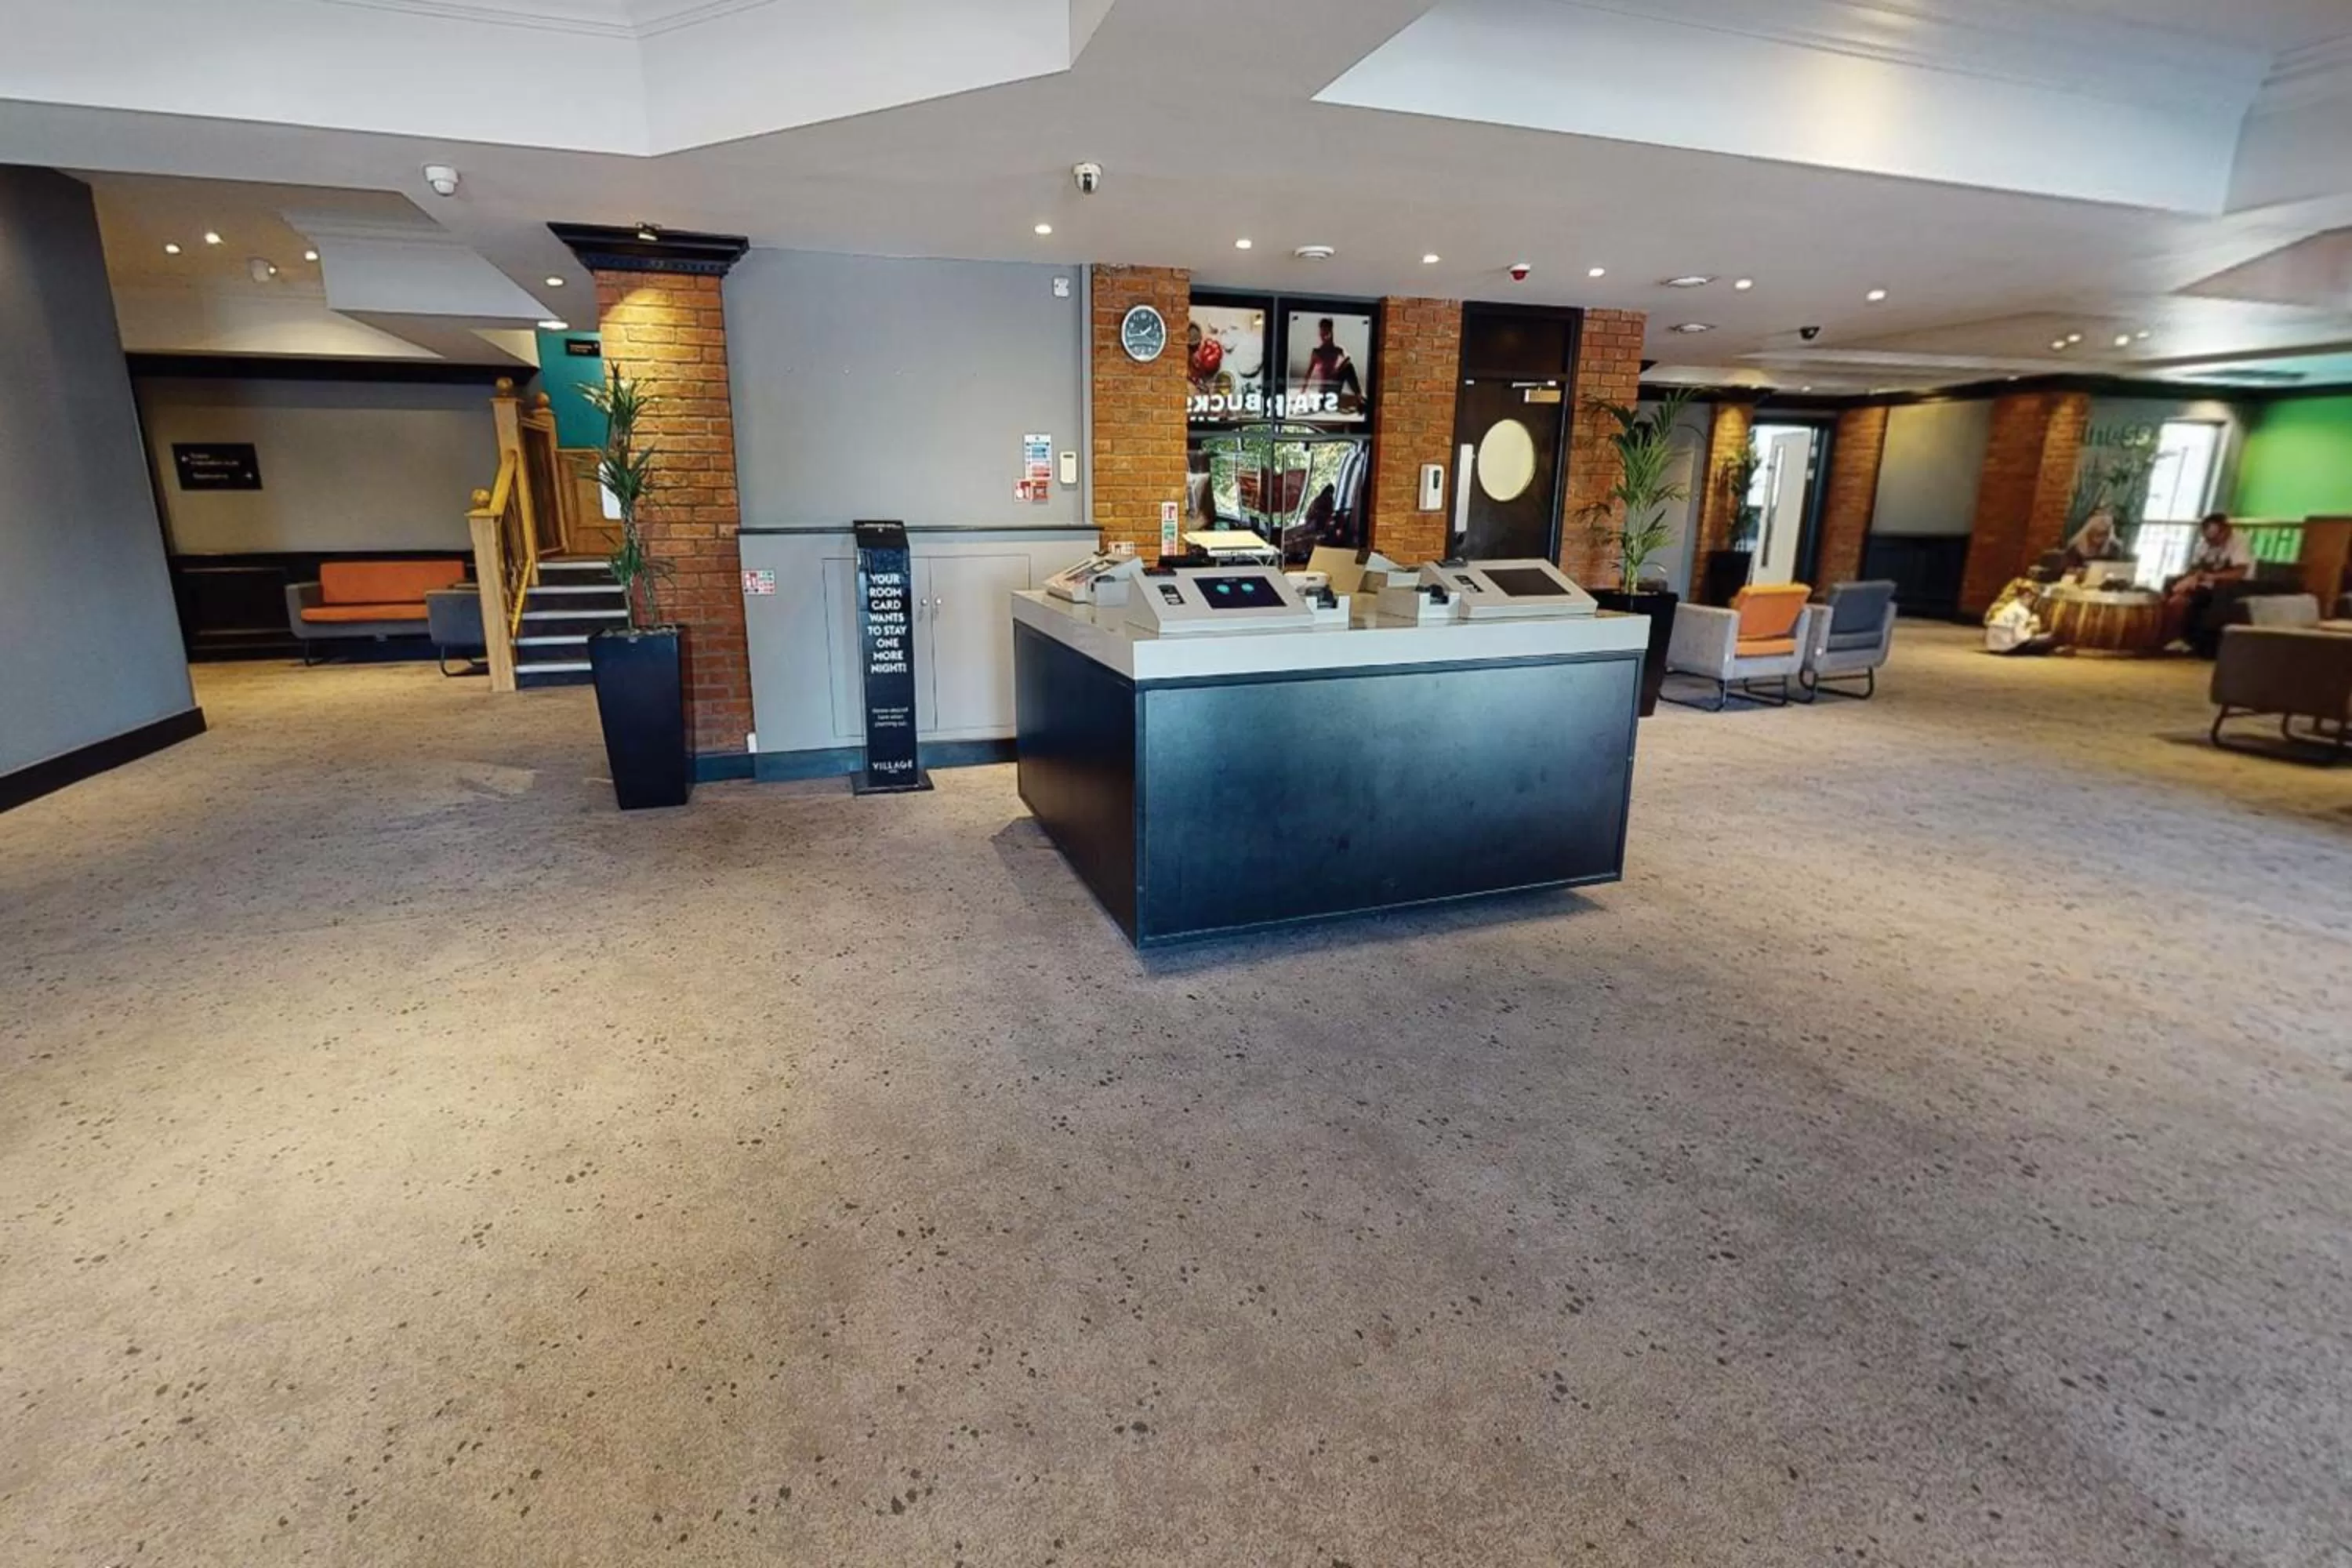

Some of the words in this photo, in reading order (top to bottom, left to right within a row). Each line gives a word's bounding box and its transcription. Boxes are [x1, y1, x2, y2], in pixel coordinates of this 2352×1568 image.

[869, 573, 901, 585] YOUR
[869, 586, 902, 597] ROOM
[871, 600, 901, 611] CARD
[869, 612, 905, 623] WANTS
[867, 626, 882, 636] TO
[884, 625, 907, 636] STAY
[876, 637, 899, 648] ONE
[873, 650, 903, 661] MORE
[872, 759, 913, 771] VILLAGE
